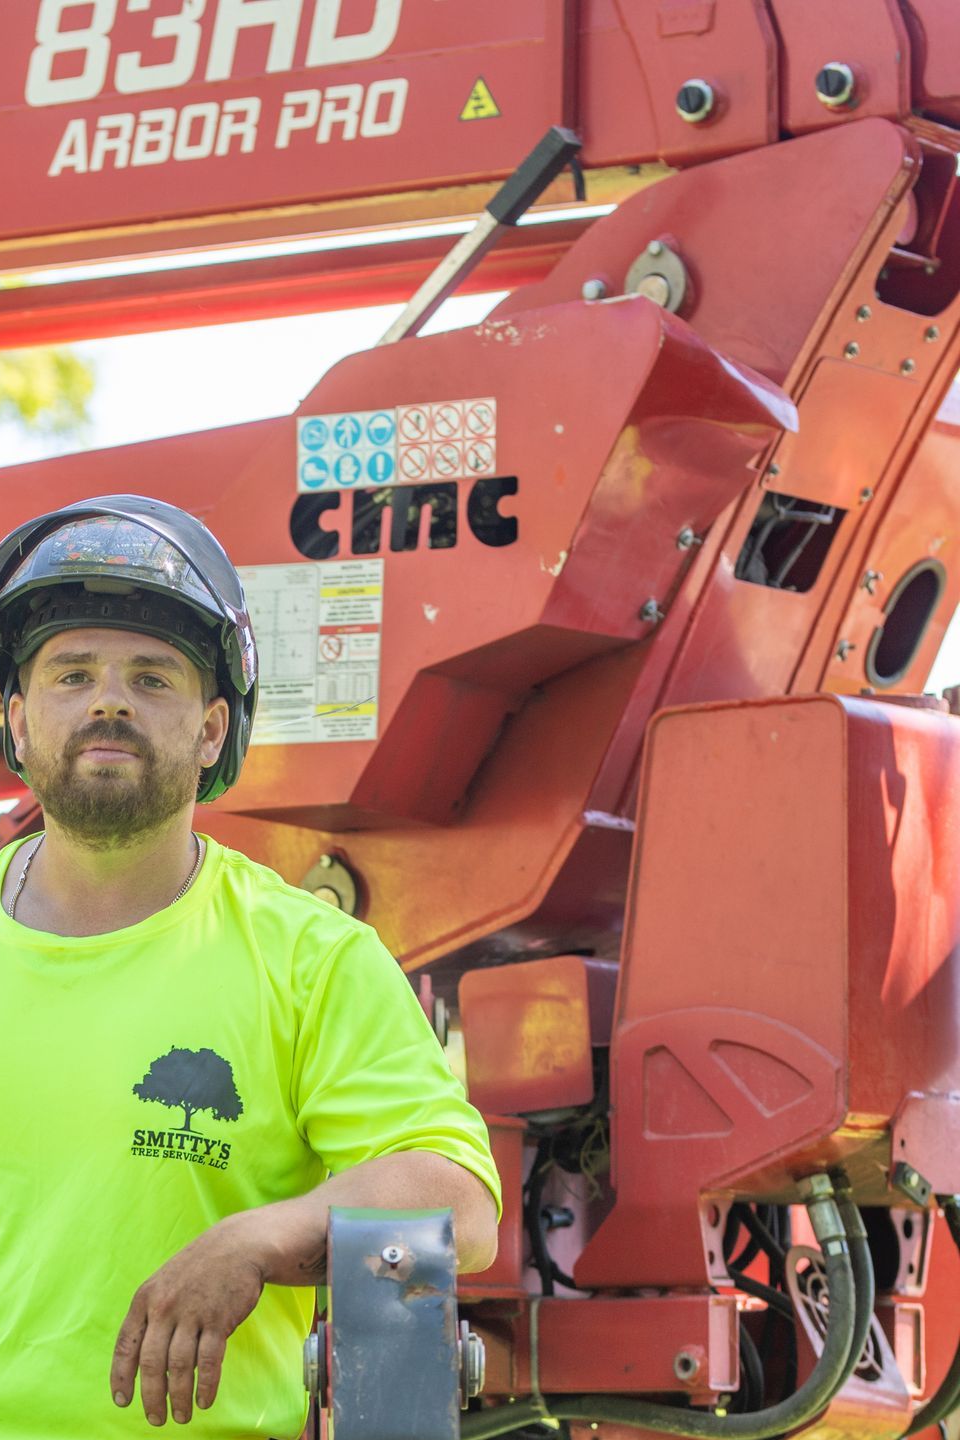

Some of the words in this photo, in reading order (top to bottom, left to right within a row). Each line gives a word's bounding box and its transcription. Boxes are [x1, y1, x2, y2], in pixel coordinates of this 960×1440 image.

[26, 0, 401, 106] 83HD
[48, 97, 261, 177] ARBOR
[275, 78, 409, 149] PRO
[131, 1147, 159, 1158] TREE
[162, 1150, 206, 1166] SERVICE,
[208, 1158, 229, 1170] LLC
